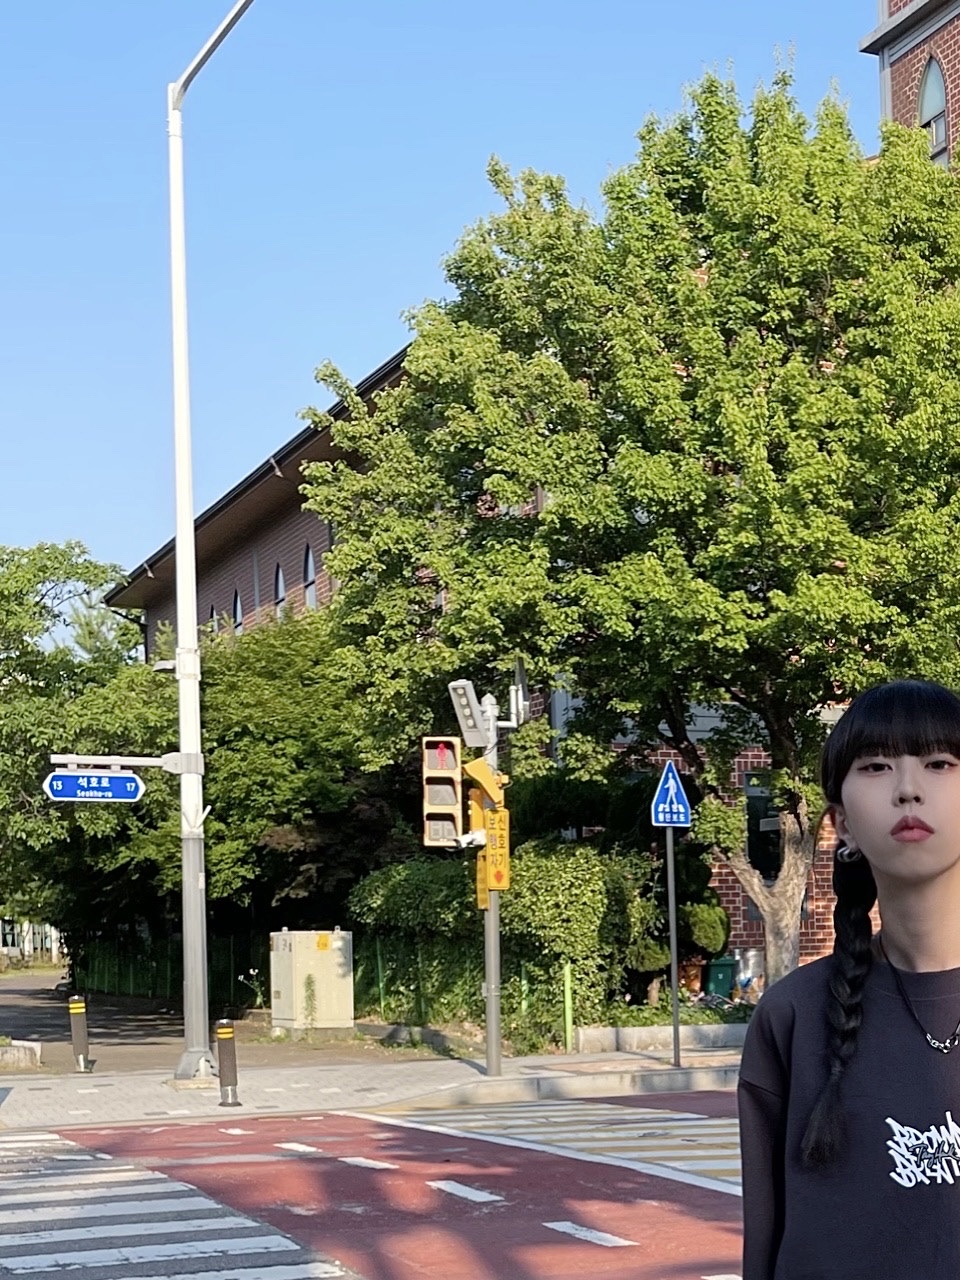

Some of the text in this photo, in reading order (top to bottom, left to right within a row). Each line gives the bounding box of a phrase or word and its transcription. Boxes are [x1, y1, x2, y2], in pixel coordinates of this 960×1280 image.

[52, 781, 62, 790] 13
[77, 777, 110, 788] 석호로
[125, 782, 136, 791] 17
